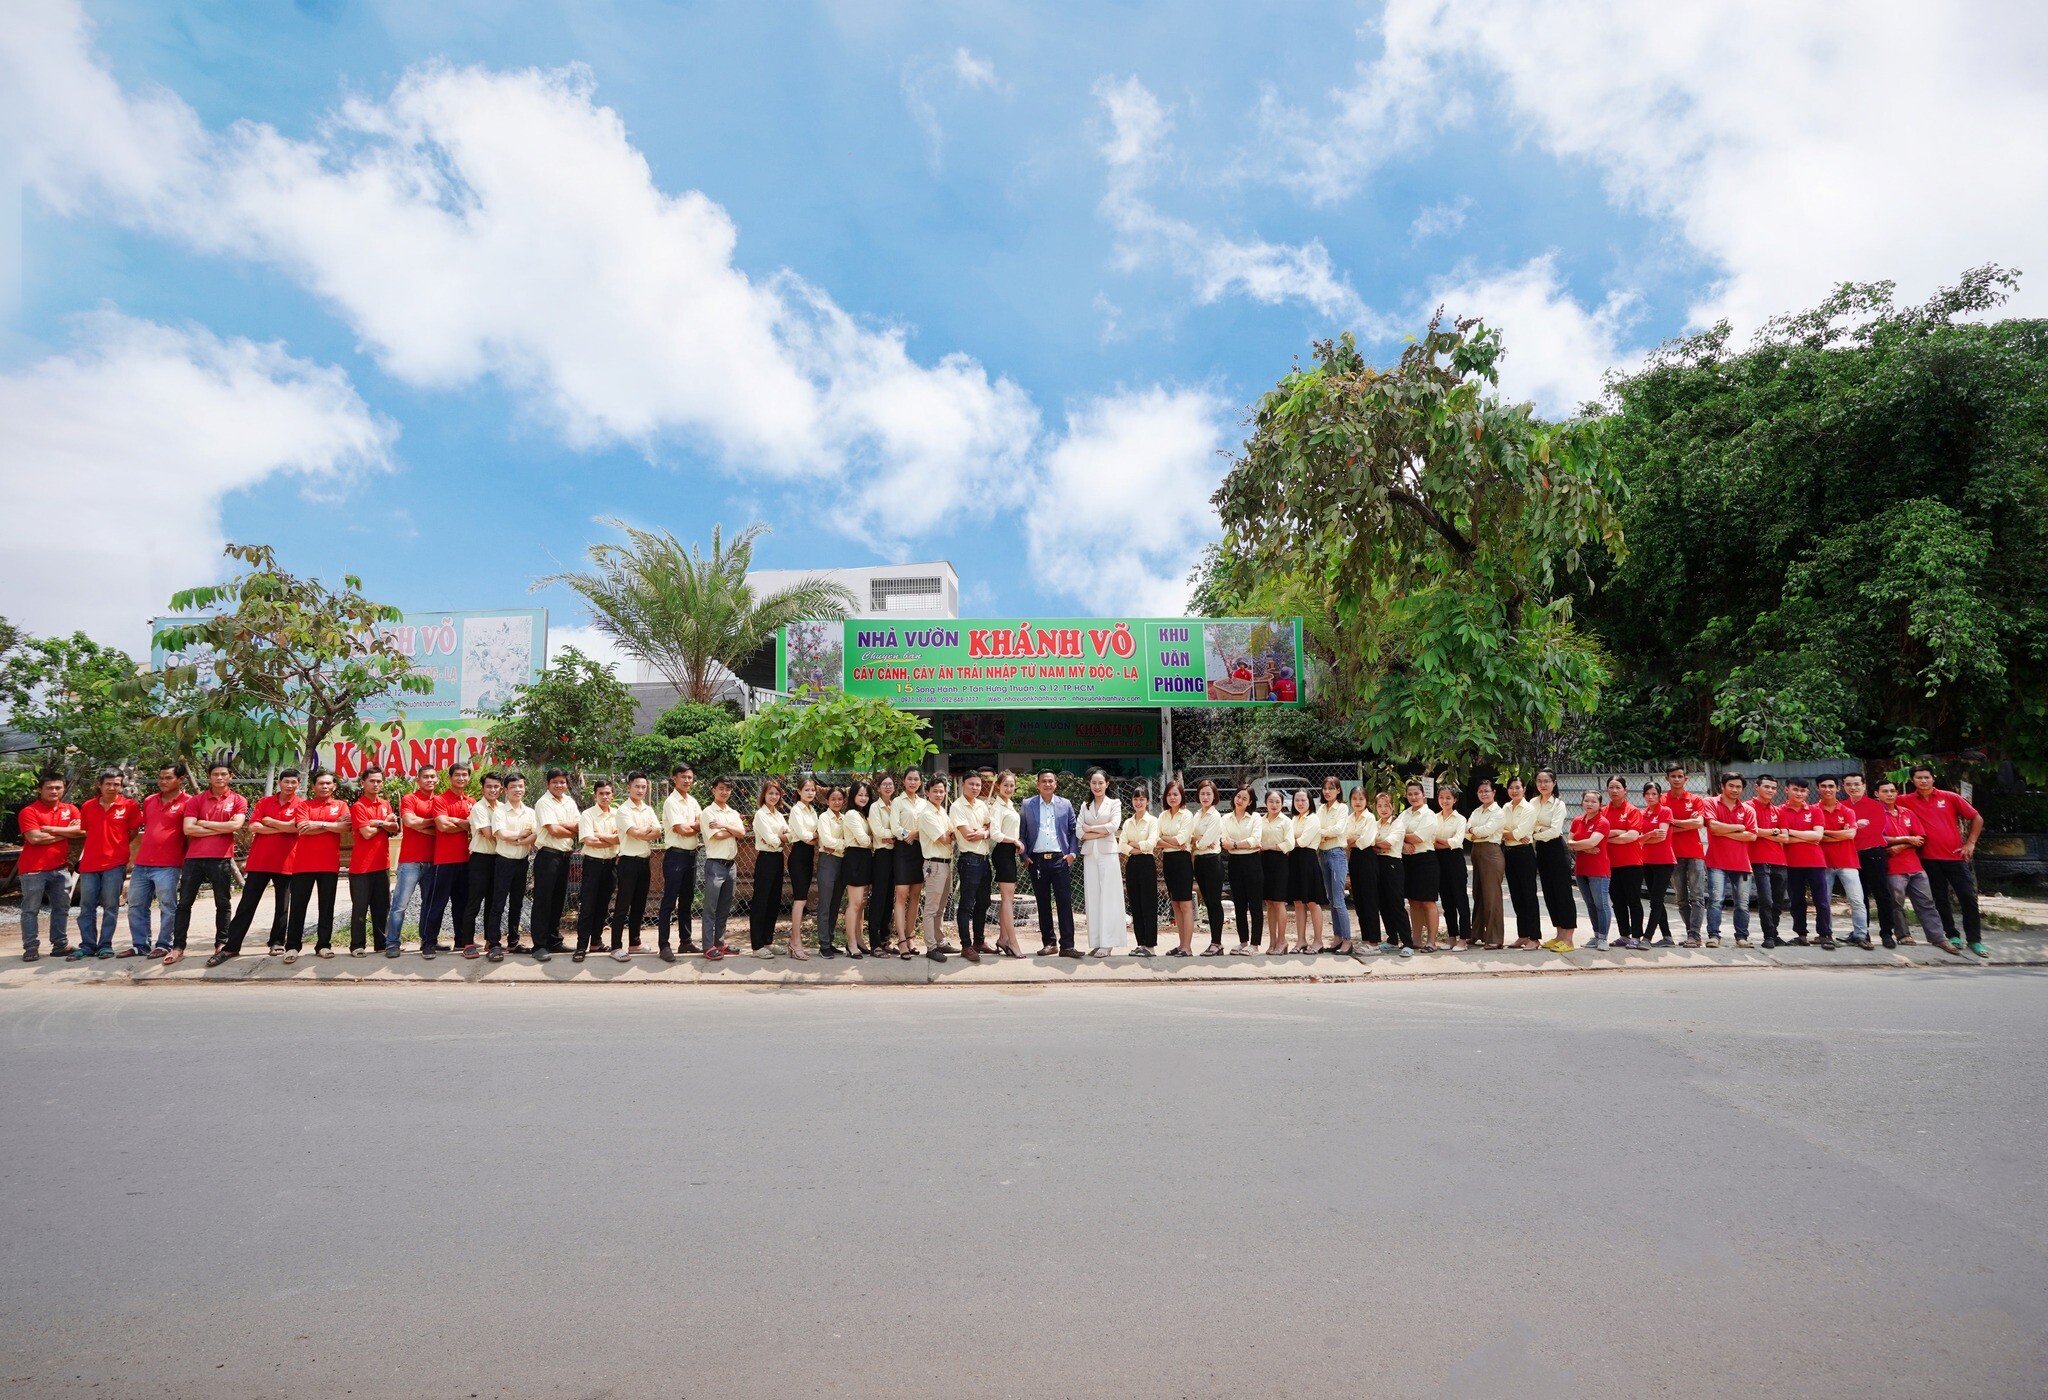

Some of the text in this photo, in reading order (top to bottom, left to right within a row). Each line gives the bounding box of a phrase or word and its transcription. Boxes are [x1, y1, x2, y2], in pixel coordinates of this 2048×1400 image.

[420, 617, 457, 655] VÕ
[858, 621, 1137, 659] NHÀ VƯỜN KHÁNH VÕ
[1159, 628, 1189, 642] KHU
[861, 650, 900, 662] Chuyên
[1160, 650, 1190, 667] VĂN
[853, 665, 875, 680] CÂY
[877, 663, 911, 682] CẢNH,
[913, 664, 936, 680] CÂY
[938, 664, 955, 679] ĂN
[957, 664, 983, 680] TRÁI
[986, 664, 1018, 683] NHẬP
[1020, 662, 1037, 679] TỪ
[1039, 665, 1066, 679] NAM
[1068, 662, 1086, 679] MỸ
[1088, 664, 1114, 683] ĐỘC
[1123, 666, 1139, 683] LẠ
[897, 683, 914, 694] 15
[1154, 674, 1204, 693] PHÒNG
[333, 728, 461, 780] KHÁNH
